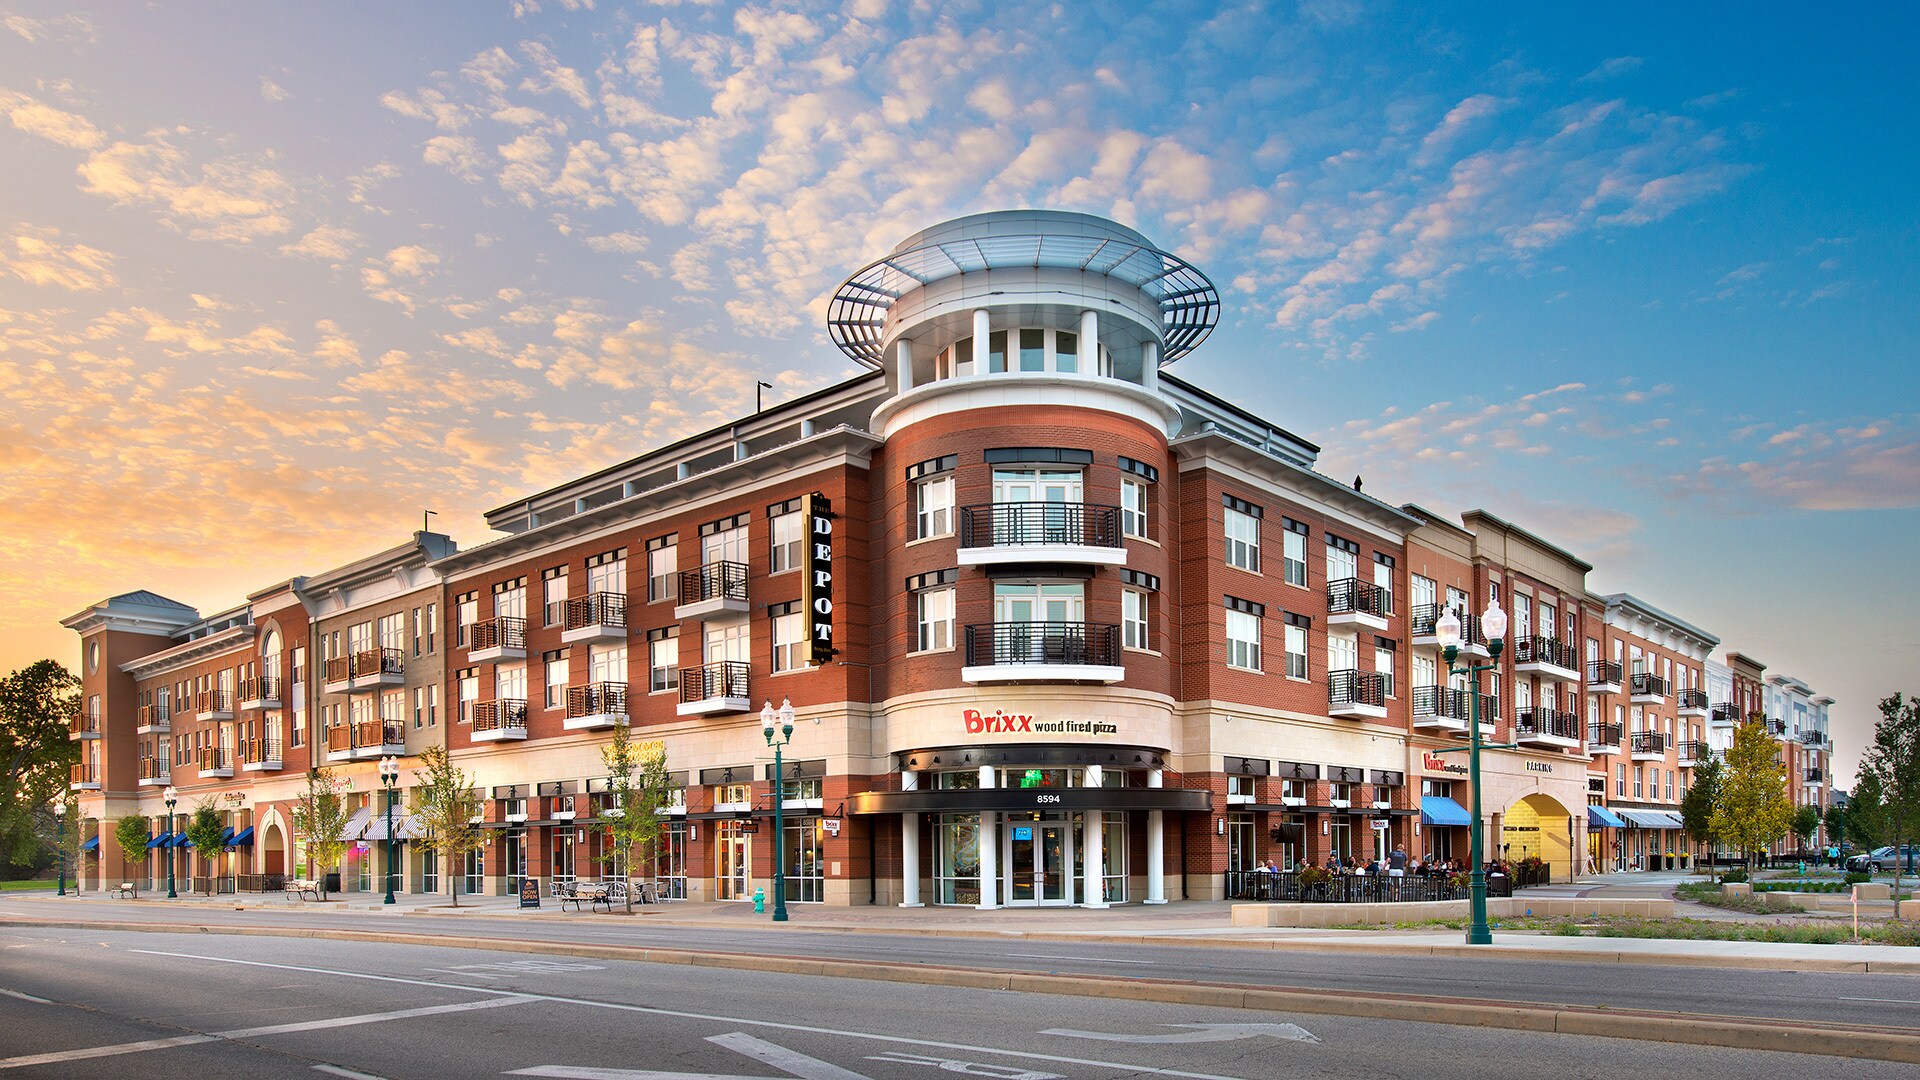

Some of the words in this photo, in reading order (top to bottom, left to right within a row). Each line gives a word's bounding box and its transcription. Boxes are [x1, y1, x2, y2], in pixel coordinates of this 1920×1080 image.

[813, 516, 833, 640] DEPOT
[963, 709, 1033, 734] Brixx
[1035, 721, 1064, 733] wood
[1066, 720, 1092, 733] fired
[1093, 721, 1117, 735] pizza
[1526, 761, 1553, 773] PARKING
[1037, 795, 1060, 804] 8594
